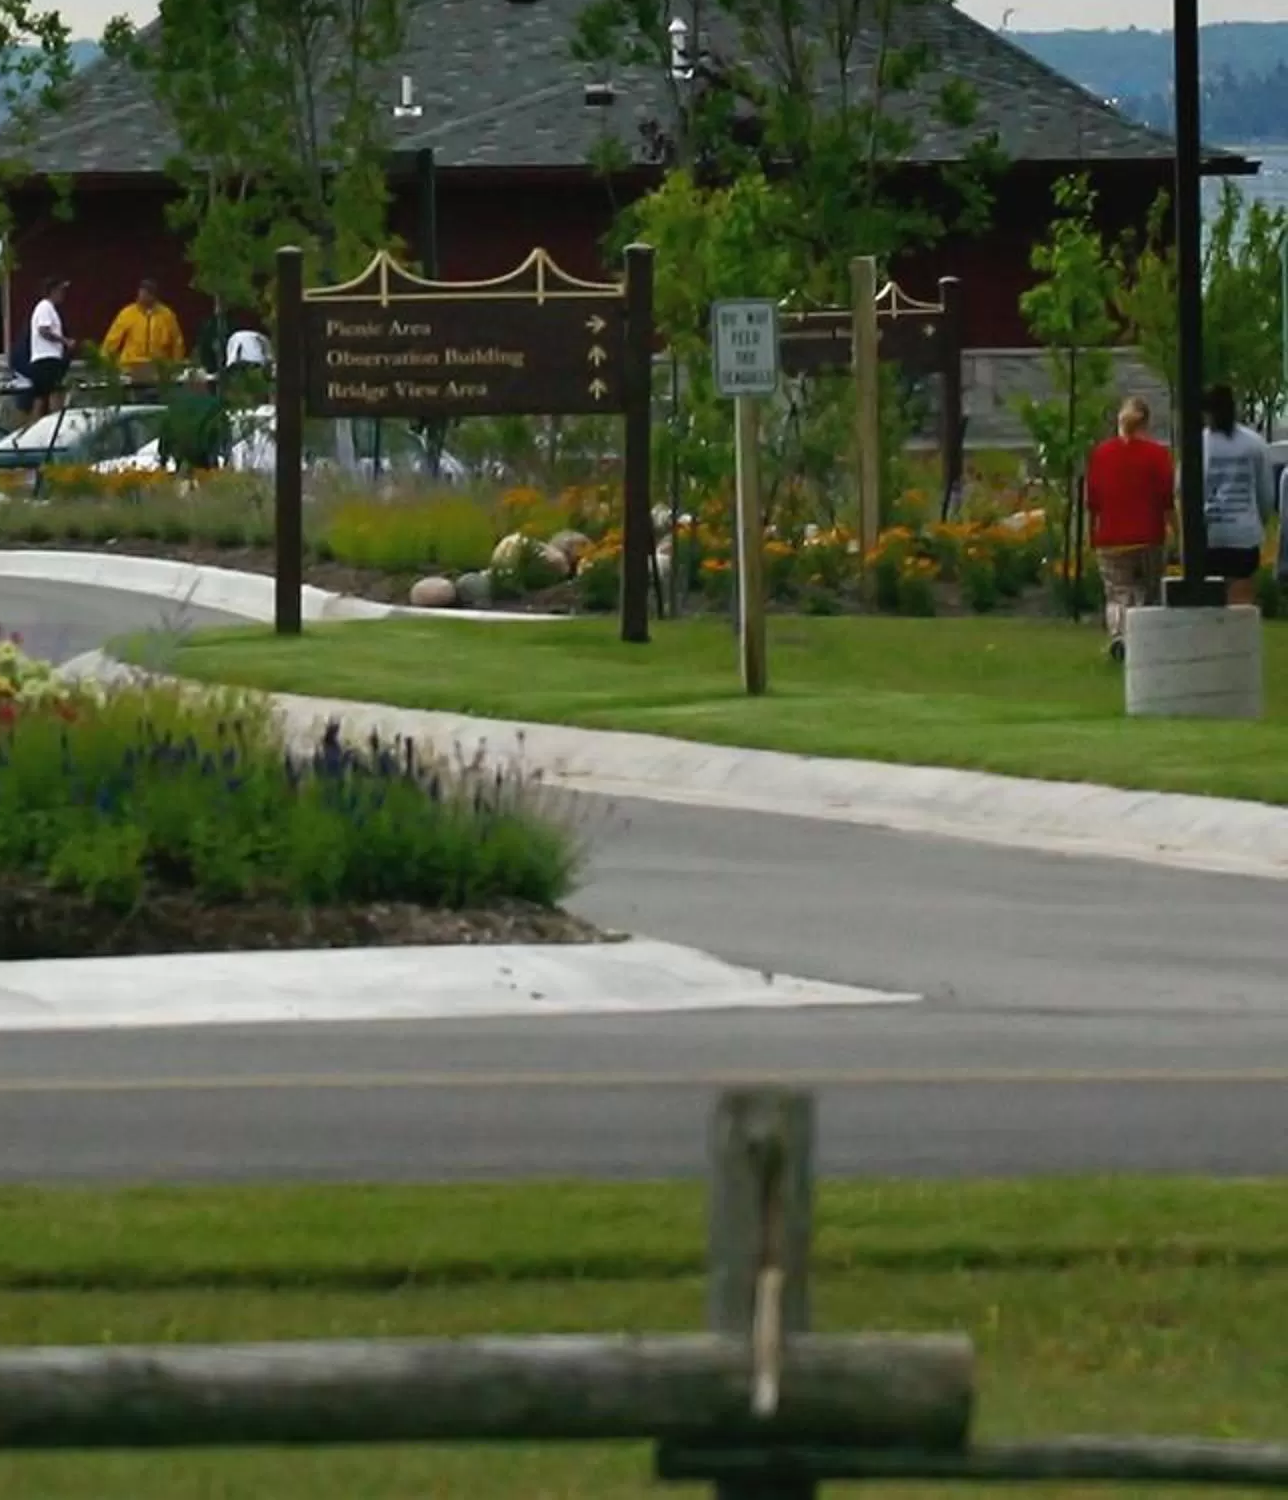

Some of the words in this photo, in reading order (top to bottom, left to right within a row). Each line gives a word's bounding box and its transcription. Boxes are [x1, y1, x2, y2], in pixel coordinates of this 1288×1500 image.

[326, 319, 383, 337] Picnic
[387, 319, 432, 337] Area
[326, 348, 439, 367] Observation
[444, 346, 525, 369] Building
[327, 380, 389, 403] Bridge
[393, 380, 440, 398] View
[442, 379, 488, 398] Area
